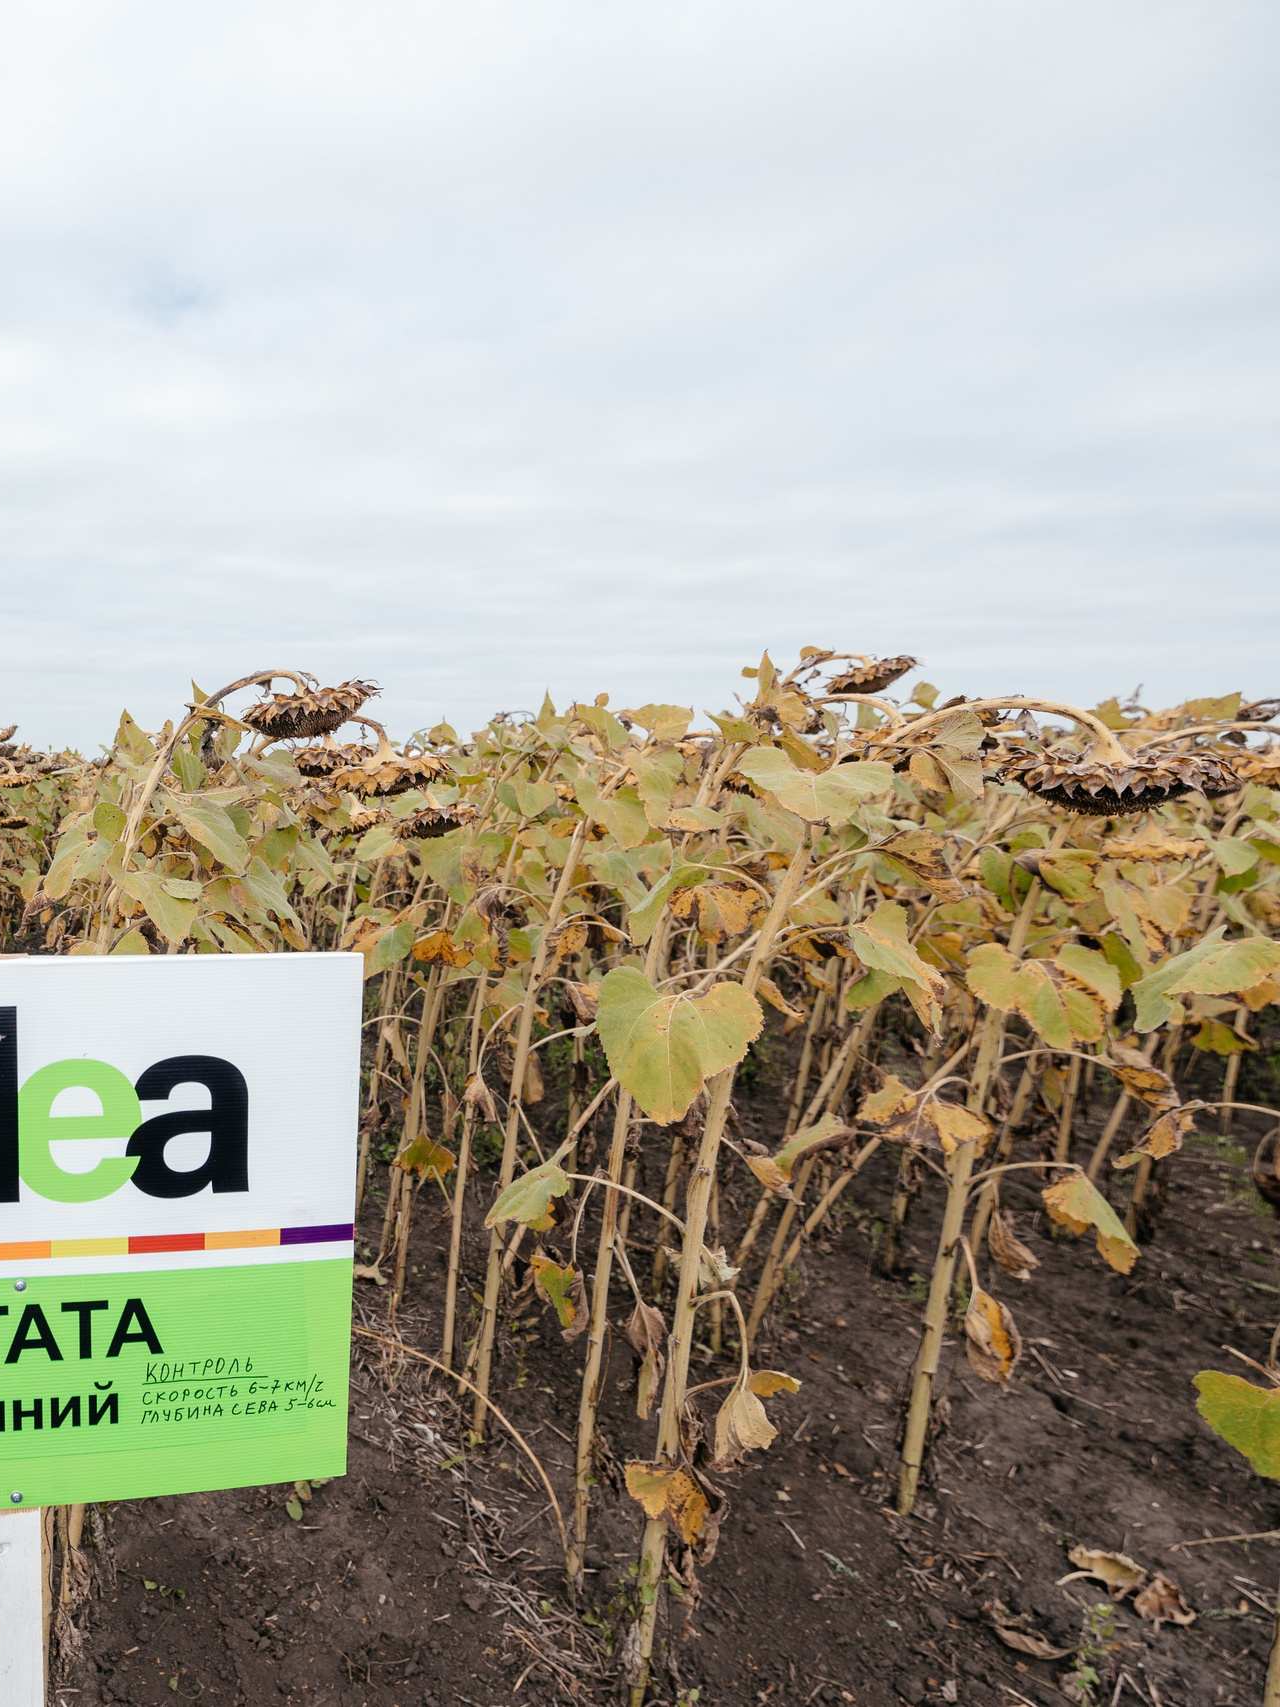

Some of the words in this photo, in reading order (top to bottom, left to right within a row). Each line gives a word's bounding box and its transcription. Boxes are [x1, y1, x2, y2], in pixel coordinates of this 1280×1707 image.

[146, 1357, 254, 1383] КОНТРОЛЬ
[142, 1384, 238, 1405] СКОРОСТЬ
[141, 1404, 224, 1424] ГЛУБИНА
[231, 1400, 279, 1415] СЕВА
